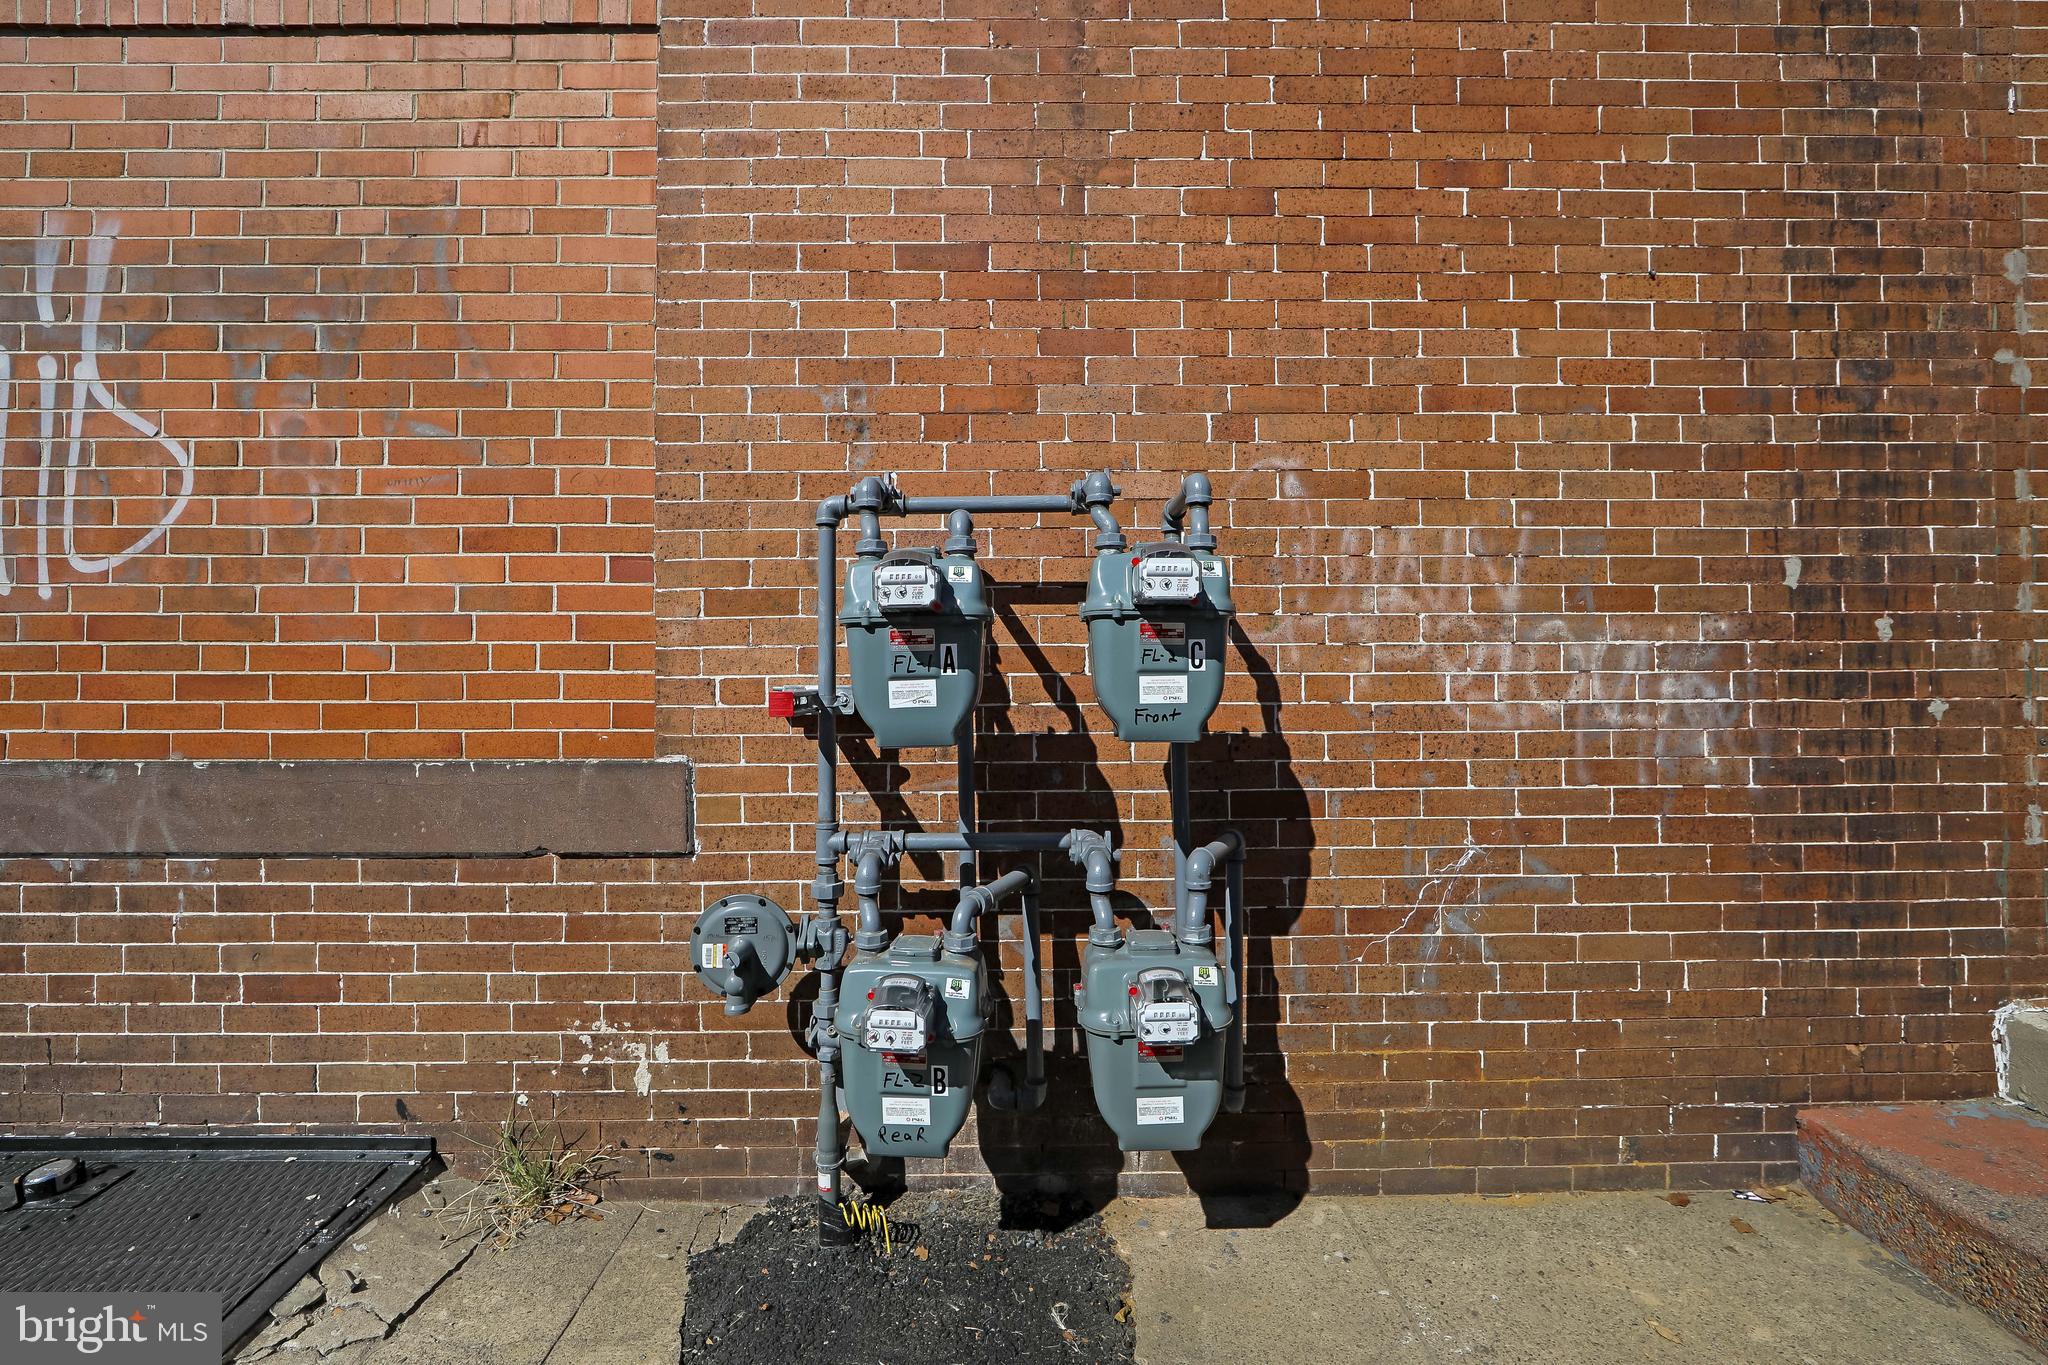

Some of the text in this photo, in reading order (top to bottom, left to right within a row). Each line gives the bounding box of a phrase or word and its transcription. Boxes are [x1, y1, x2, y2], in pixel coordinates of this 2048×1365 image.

[893, 654, 933, 673] FL-1
[943, 645, 956, 673] A
[1191, 641, 1203, 669] C
[1134, 708, 1182, 725] Front
[933, 1067, 946, 1094] B
